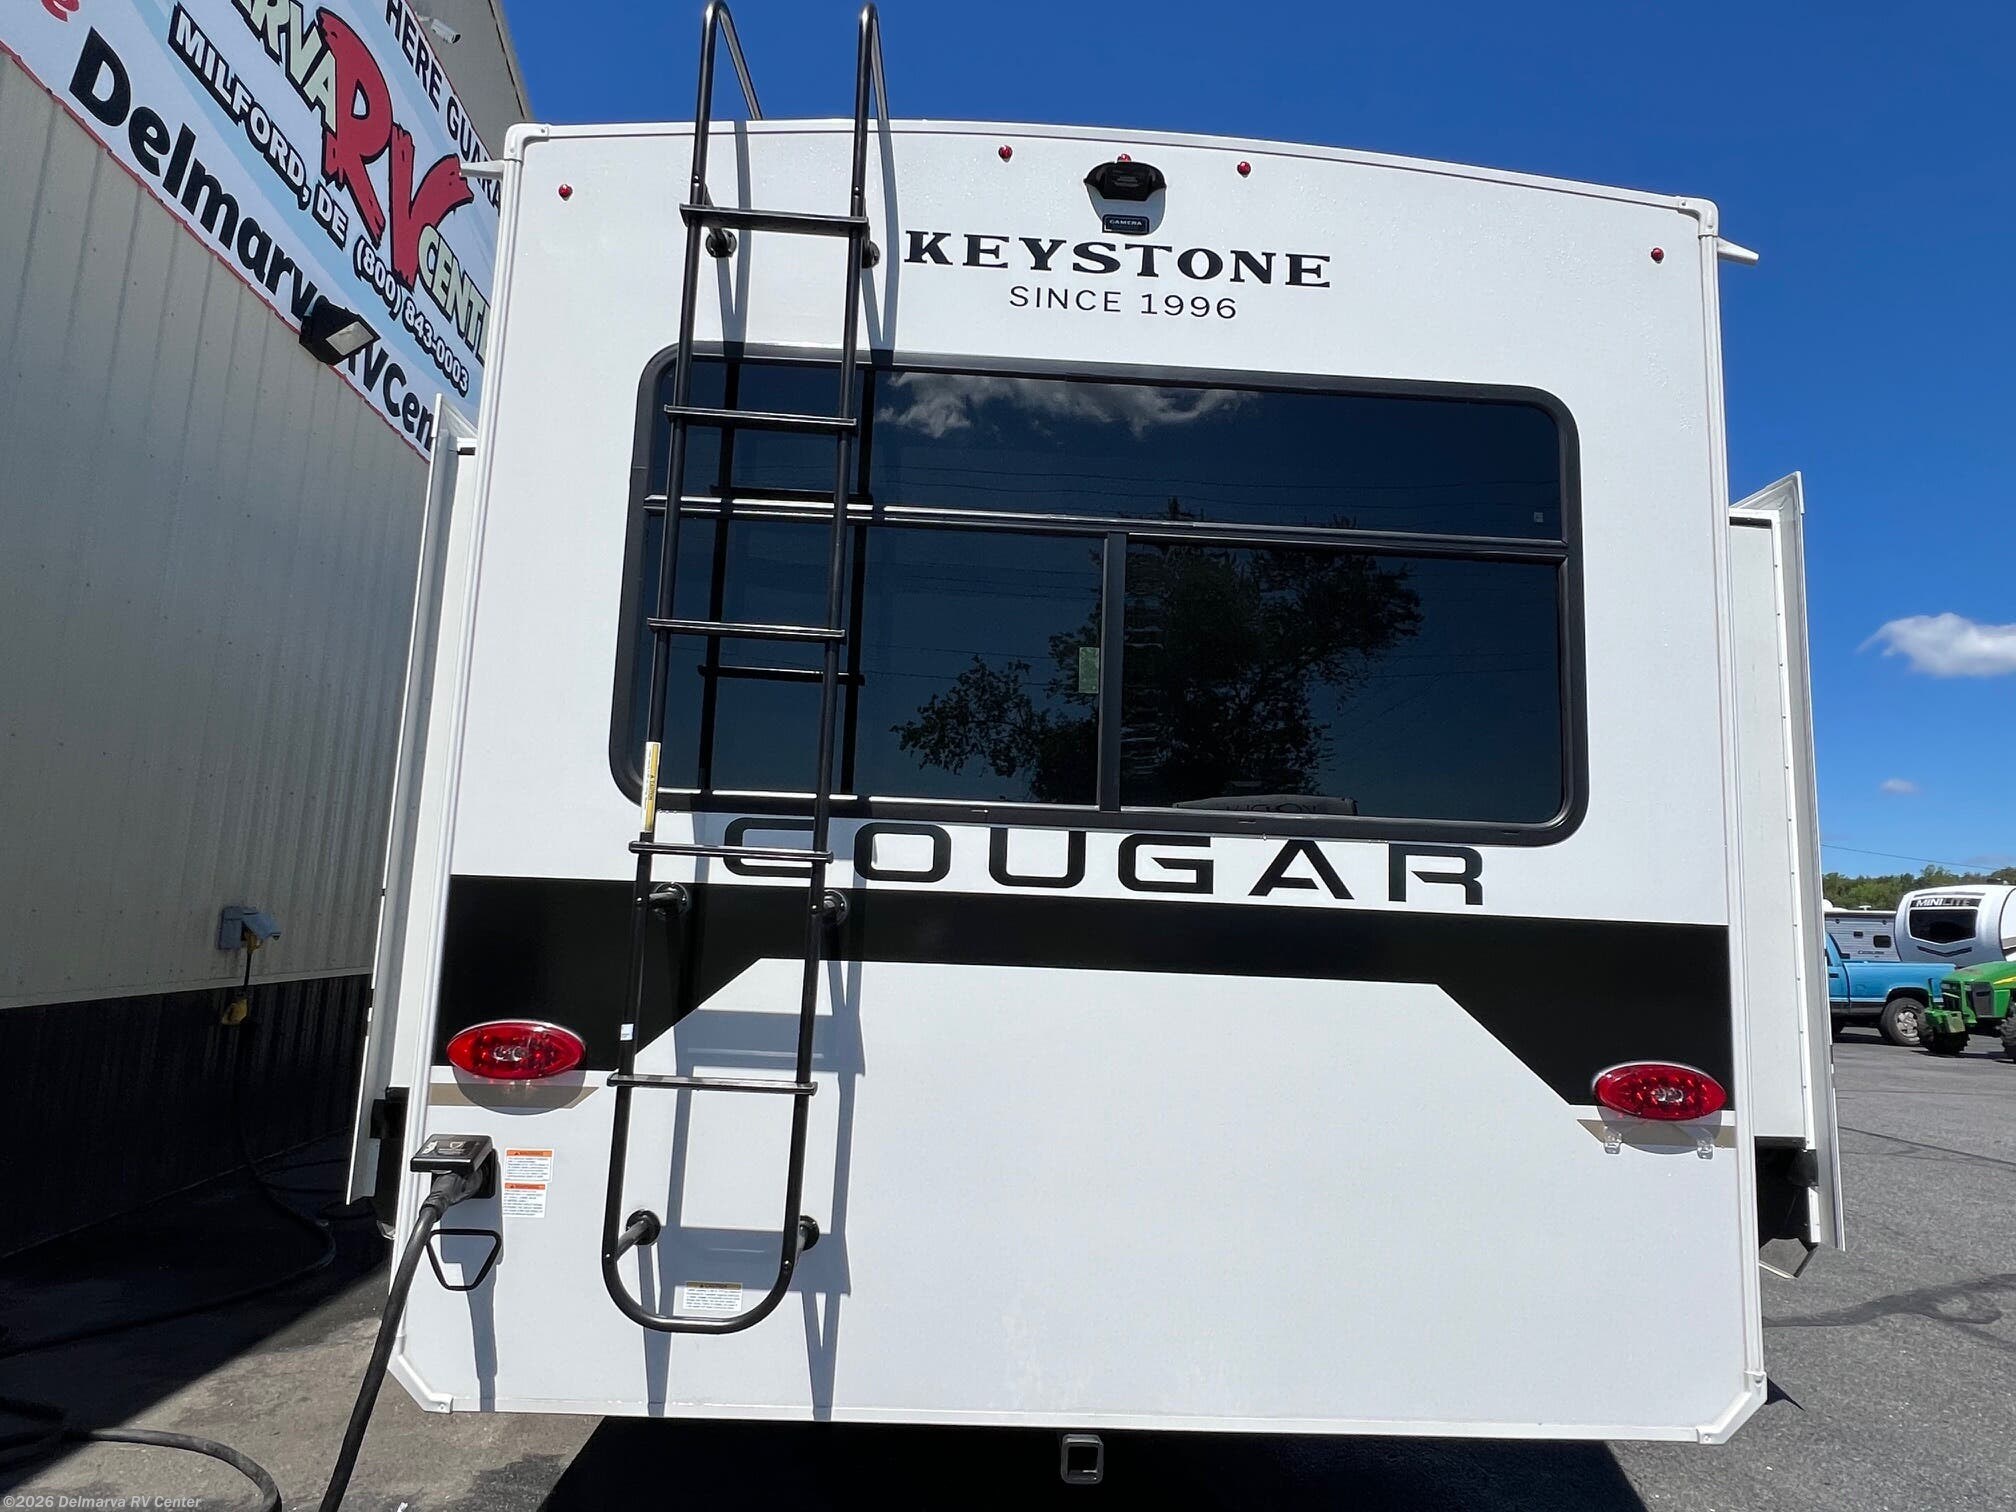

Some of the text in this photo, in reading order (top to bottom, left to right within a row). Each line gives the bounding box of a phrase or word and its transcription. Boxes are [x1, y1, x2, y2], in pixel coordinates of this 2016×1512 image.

[169, 2, 469, 397] MILFORD, DE (800) 843-0003
[904, 230, 1331, 288] KEYSTONE
[1009, 285, 1237, 319] SINCE 1996
[723, 817, 1484, 905] COUGAR
